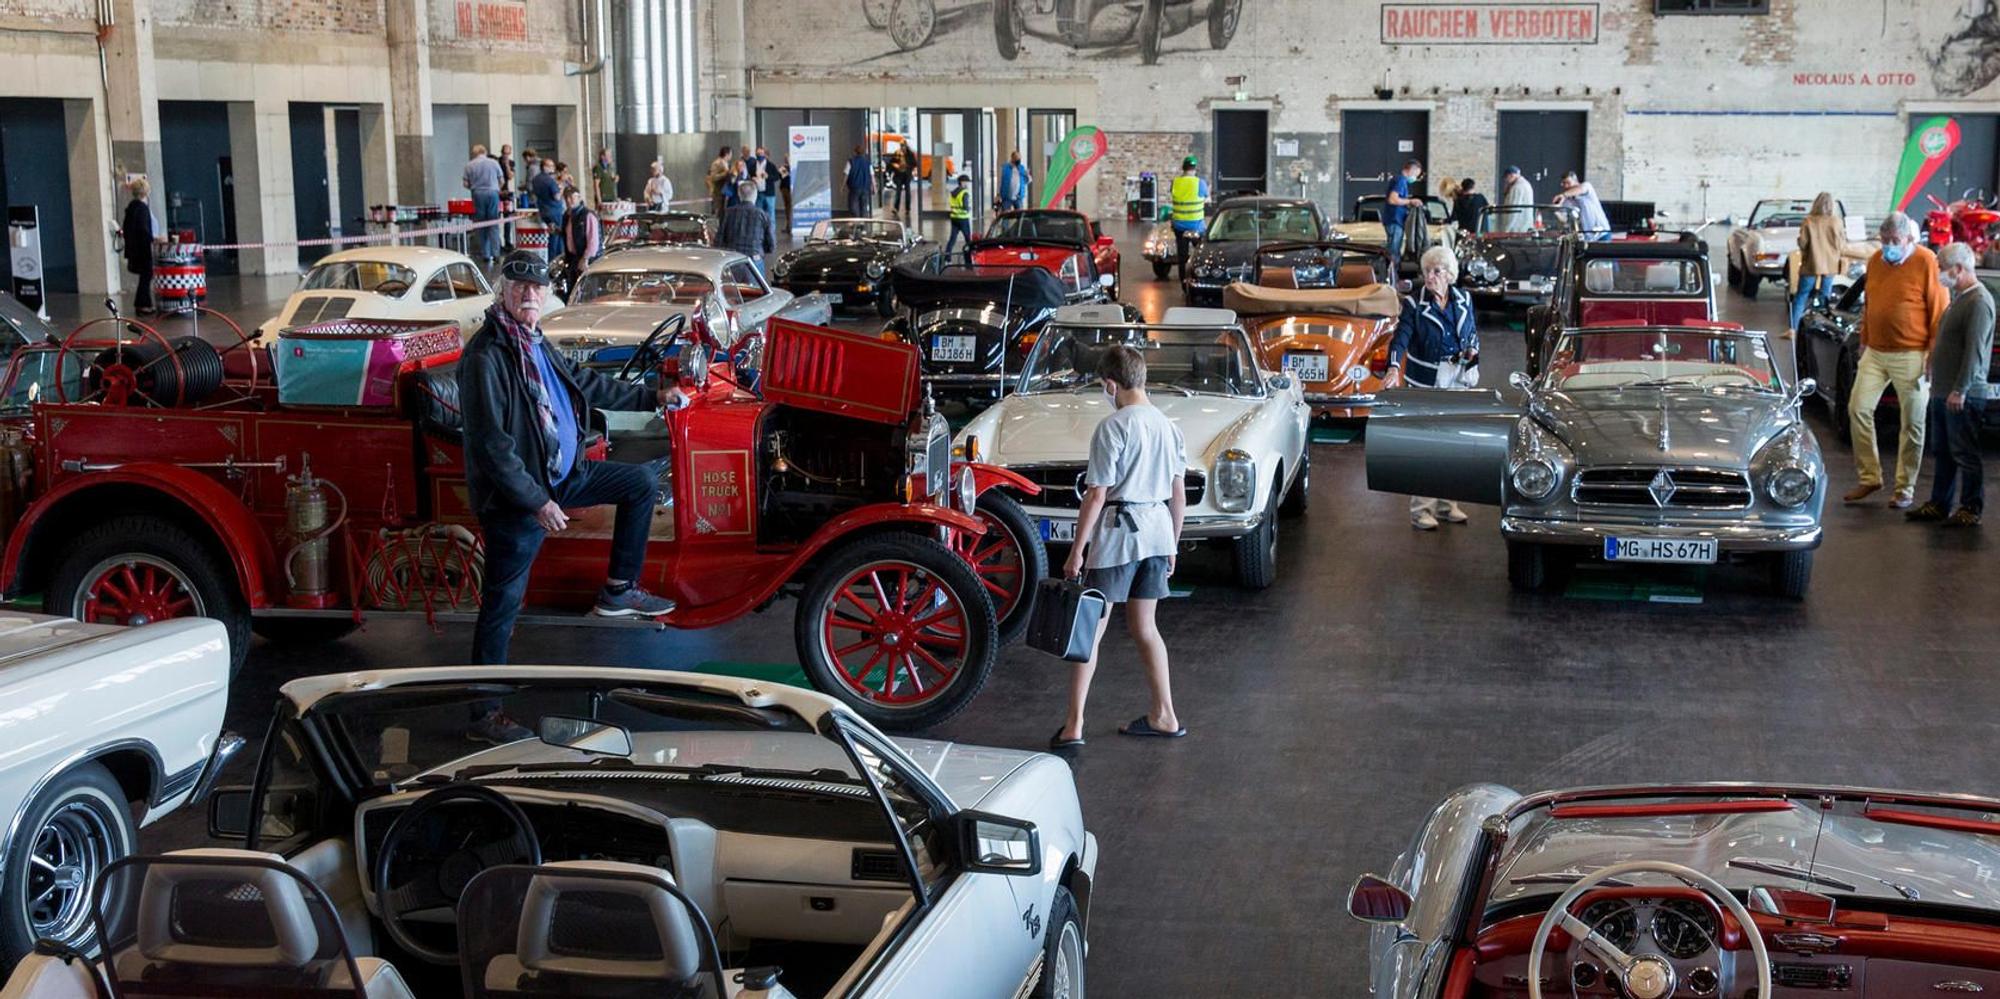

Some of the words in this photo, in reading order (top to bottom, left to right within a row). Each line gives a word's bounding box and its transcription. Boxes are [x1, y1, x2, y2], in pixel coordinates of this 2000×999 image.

[1387, 9, 1478, 38] RAUCHEN
[1489, 9, 1593, 40] VERBOTEN
[1793, 73, 1855, 85] NICOLAUS
[1877, 73, 1916, 85] OTTO
[941, 337, 953, 348] BM
[1292, 356, 1305, 367] BM
[703, 471, 736, 483] HOSE
[701, 485, 739, 497] TRUCK
[1051, 522, 1059, 538] K
[1617, 541, 1639, 557] MG
[1651, 541, 1673, 558] HS
